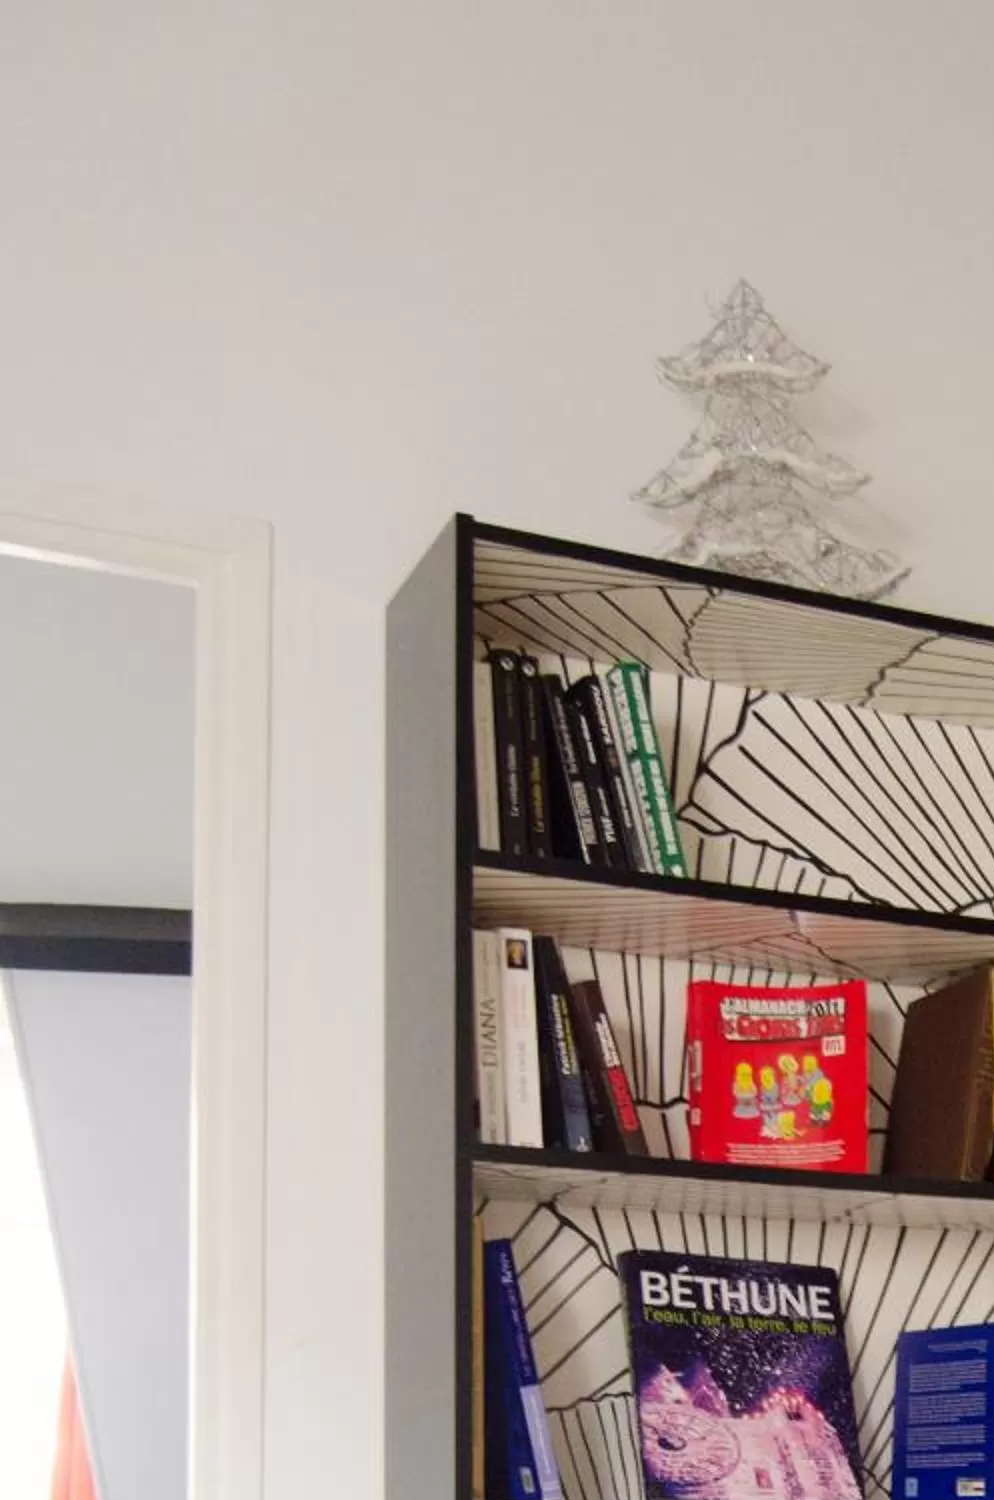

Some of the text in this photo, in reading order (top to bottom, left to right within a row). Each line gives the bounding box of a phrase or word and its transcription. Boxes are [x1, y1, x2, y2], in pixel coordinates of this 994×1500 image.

[479, 999, 498, 1069] DIANA
[640, 1266, 835, 1320] BÉTHUNE
[643, 1307, 688, 1327] l'eau,
[730, 1314, 745, 1329] la
[812, 1320, 836, 1336] feu
